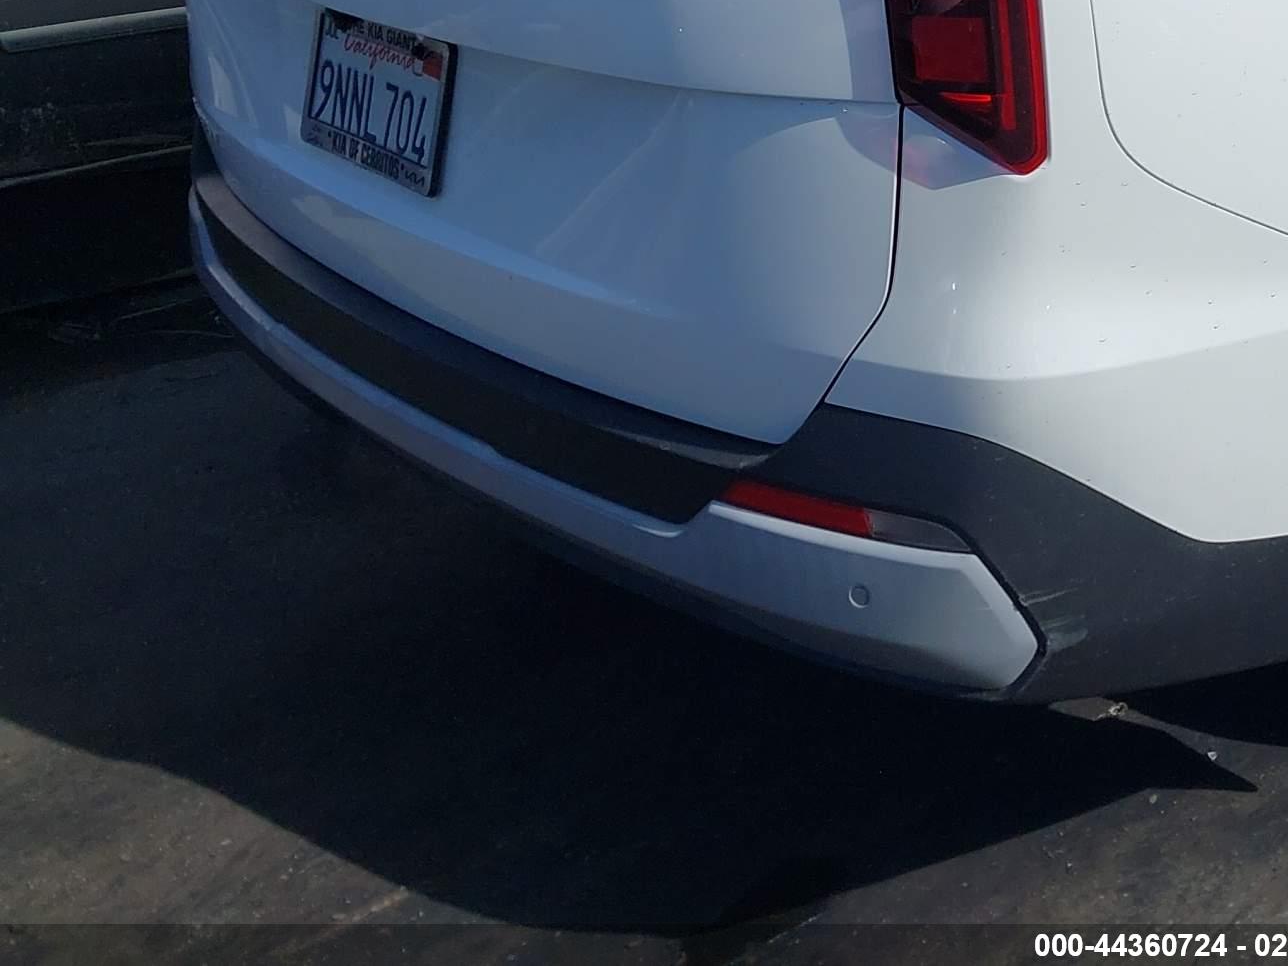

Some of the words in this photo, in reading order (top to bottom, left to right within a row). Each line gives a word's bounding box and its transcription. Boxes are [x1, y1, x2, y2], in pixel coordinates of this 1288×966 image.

[314, 60, 377, 143] 9NNL
[384, 81, 428, 164] 704
[331, 131, 346, 156] KIA
